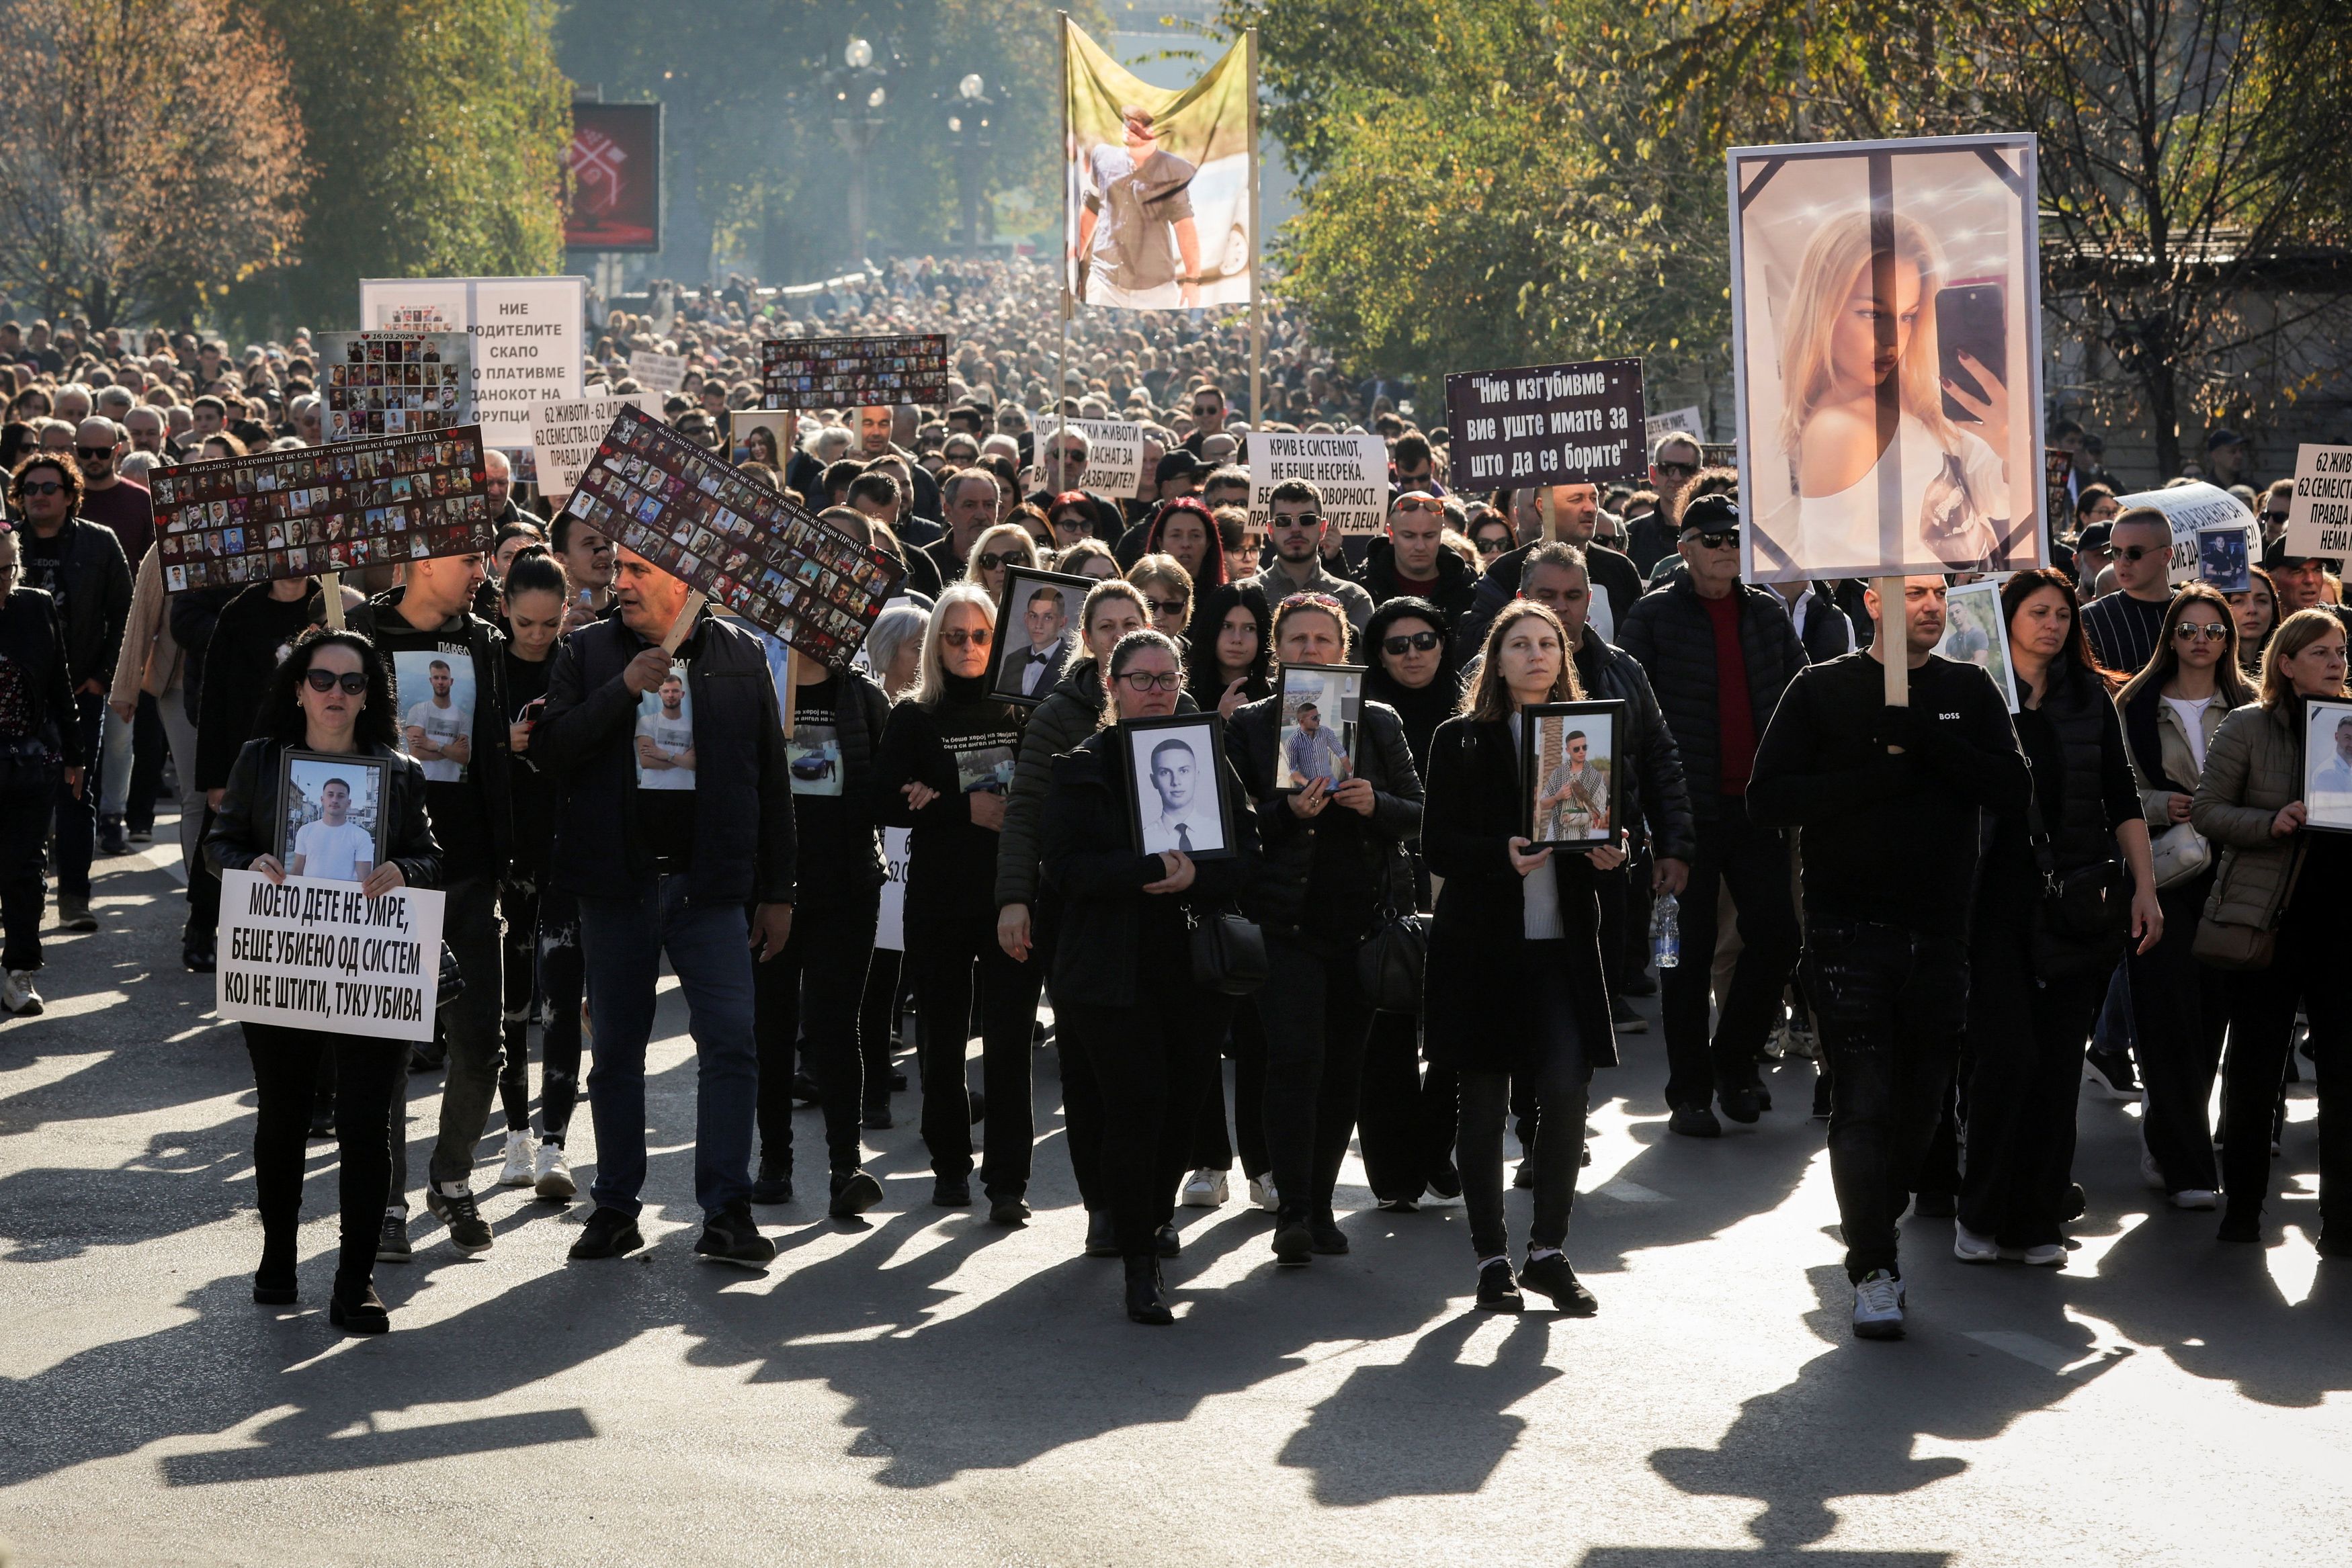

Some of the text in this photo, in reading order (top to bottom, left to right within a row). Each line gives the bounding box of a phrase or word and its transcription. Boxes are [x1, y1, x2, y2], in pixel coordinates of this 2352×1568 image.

[499, 304, 528, 315] НИЕ
[467, 324, 562, 339] РОДИТЕЛИТЕ
[491, 346, 538, 358] СКАПО
[487, 367, 565, 380] ПЛАТИВМЕ
[542, 388, 560, 400] НА
[1472, 377, 1509, 404] "Ние
[1517, 370, 1605, 401] изгубивме
[472, 410, 530, 424] ОРУПЦИ
[545, 407, 555, 423] 62
[555, 404, 589, 423] ЖИВОТИ
[595, 402, 605, 419] 62
[1101, 424, 1139, 442] ЖИВОТИ
[1467, 406, 1628, 441] вие уште имате за
[536, 429, 545, 446] 62
[546, 427, 588, 445] СЕМЕЈСТВА
[589, 425, 599, 441] СО
[190, 462, 230, 474] 16.03.2025
[249, 455, 274, 466] сенки
[297, 449, 325, 460] следат
[332, 444, 353, 455] секој
[355, 441, 382, 451] поглед
[384, 439, 403, 447] бара
[404, 433, 438, 444] ПРАВДА
[550, 448, 582, 467] ПРАВДА
[583, 448, 589, 462] И
[1122, 448, 1133, 465] ЗА
[1269, 439, 1362, 460] КРИВ Е СИСТЕМОТ,
[1471, 453, 1504, 478] што
[1511, 451, 1534, 477] да
[1540, 449, 1558, 472] се
[1564, 439, 1628, 474] борите"
[1271, 460, 1365, 481] НЕ БЕШЕ НЕСРЕЌА.
[2316, 452, 2352, 473] 62 ЖИВ
[657, 426, 693, 451] 16.03.2025
[821, 523, 838, 540] бара
[839, 533, 867, 556] ПРАВДА
[2298, 477, 2310, 497] 62
[1351, 513, 1380, 531] ДЕЦА
[2310, 503, 2349, 529] ПРАВДА
[2320, 530, 2347, 551] НЕМА
[249, 882, 409, 934] МОЕТО ДЕТЕ НЕ УМРЕ,
[232, 927, 421, 977] БЕШЕ УБИЕНО ОД СИСТЕМ
[225, 971, 422, 1022] КОЈ НЕ ШТИТИ, ТУКУ УБИВА
